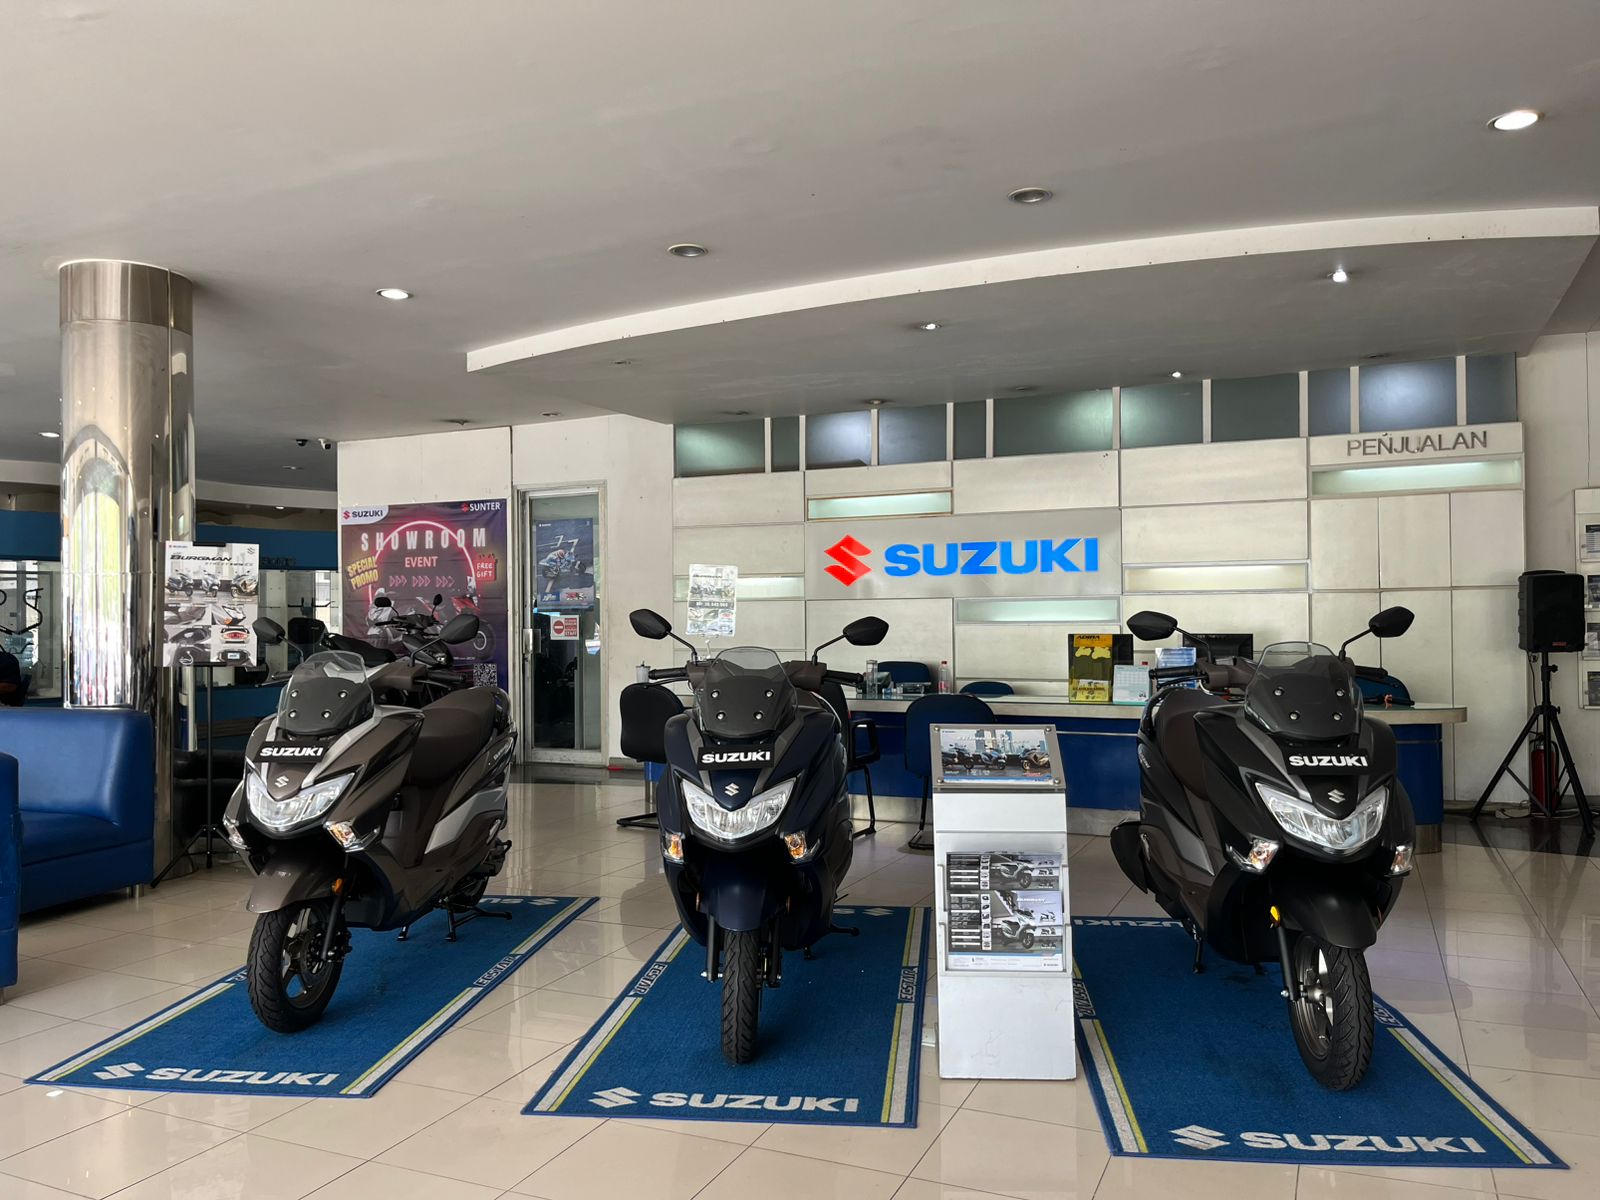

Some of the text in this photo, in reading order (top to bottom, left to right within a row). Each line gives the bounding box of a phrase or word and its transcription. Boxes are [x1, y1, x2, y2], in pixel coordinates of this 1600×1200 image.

[1347, 431, 1487, 456] PENJUALAN
[469, 502, 500, 512] SUNTER
[351, 509, 384, 518] SUZUKI
[361, 528, 486, 551] SHOWROOM
[405, 556, 439, 568] EVENT
[884, 537, 1098, 577] SUZUKI
[347, 556, 378, 577] SPECIAL
[476, 562, 493, 570] FREE
[350, 569, 379, 589] PROMO
[476, 570, 493, 578] GIFT
[260, 747, 323, 757] SUZUKI
[701, 751, 771, 763] SUZUKI
[1289, 755, 1368, 767] SUZUKI
[1073, 919, 1184, 928] UZUKI
[146, 1067, 339, 1086] SUZUKI
[649, 1092, 859, 1113] SUZUKI
[1240, 1131, 1486, 1153] SUZUKI
